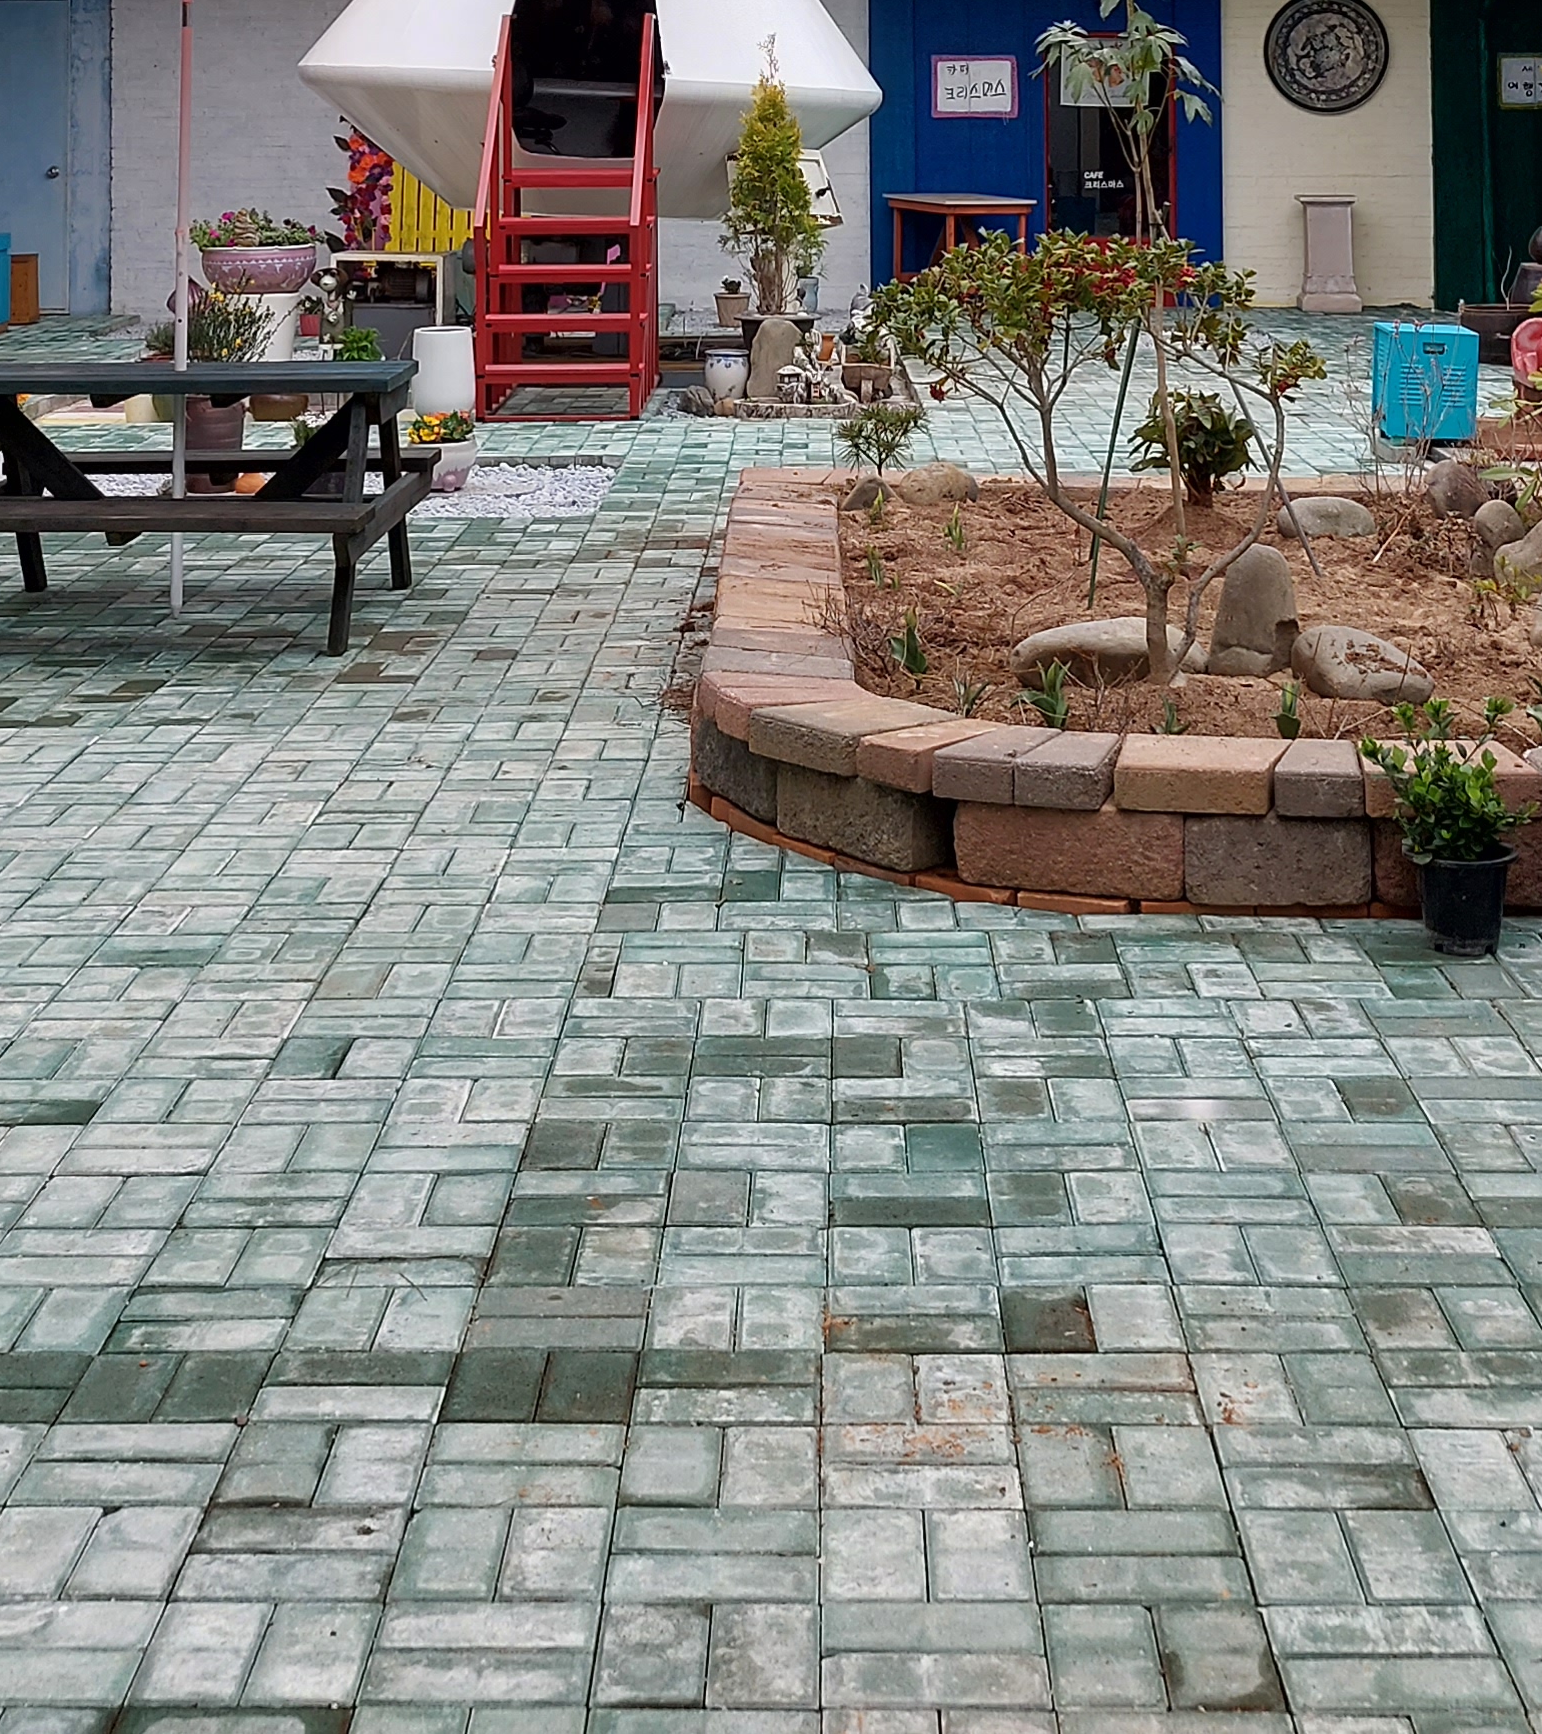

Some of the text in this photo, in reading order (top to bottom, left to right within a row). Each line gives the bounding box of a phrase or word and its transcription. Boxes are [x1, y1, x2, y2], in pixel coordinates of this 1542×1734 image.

[944, 78, 1007, 100] 크리스마스
[1083, 170, 1105, 179] CAFE
[1083, 179, 1125, 189] 크리스마스
